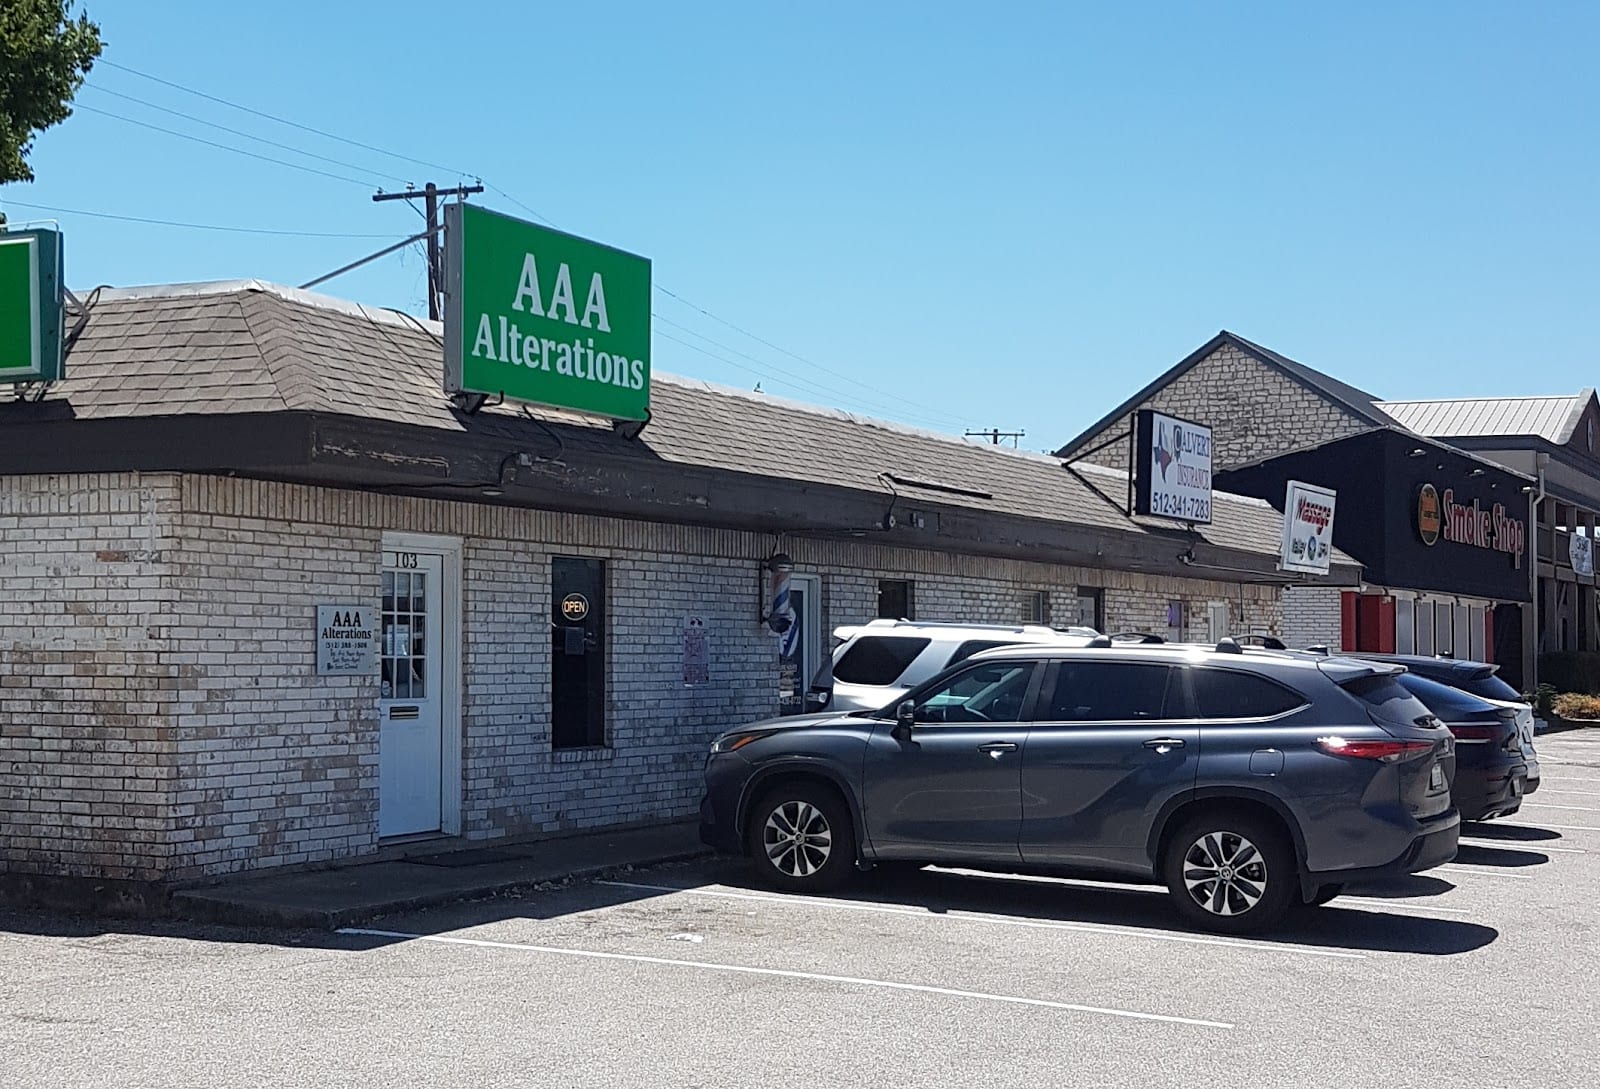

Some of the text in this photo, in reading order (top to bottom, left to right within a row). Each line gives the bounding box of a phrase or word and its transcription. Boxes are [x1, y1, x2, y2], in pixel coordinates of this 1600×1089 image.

[512, 252, 611, 333] AAA
[471, 313, 644, 390] Alterations
[1152, 492, 1209, 519] 512-341-7283
[1296, 496, 1331, 535] Massage
[1443, 489, 1491, 549] Smoke
[1493, 503, 1524, 569] Shop
[394, 552, 418, 569] 103
[332, 611, 362, 627] AAA
[563, 601, 586, 613] OPEN
[321, 627, 372, 639] Alterations
